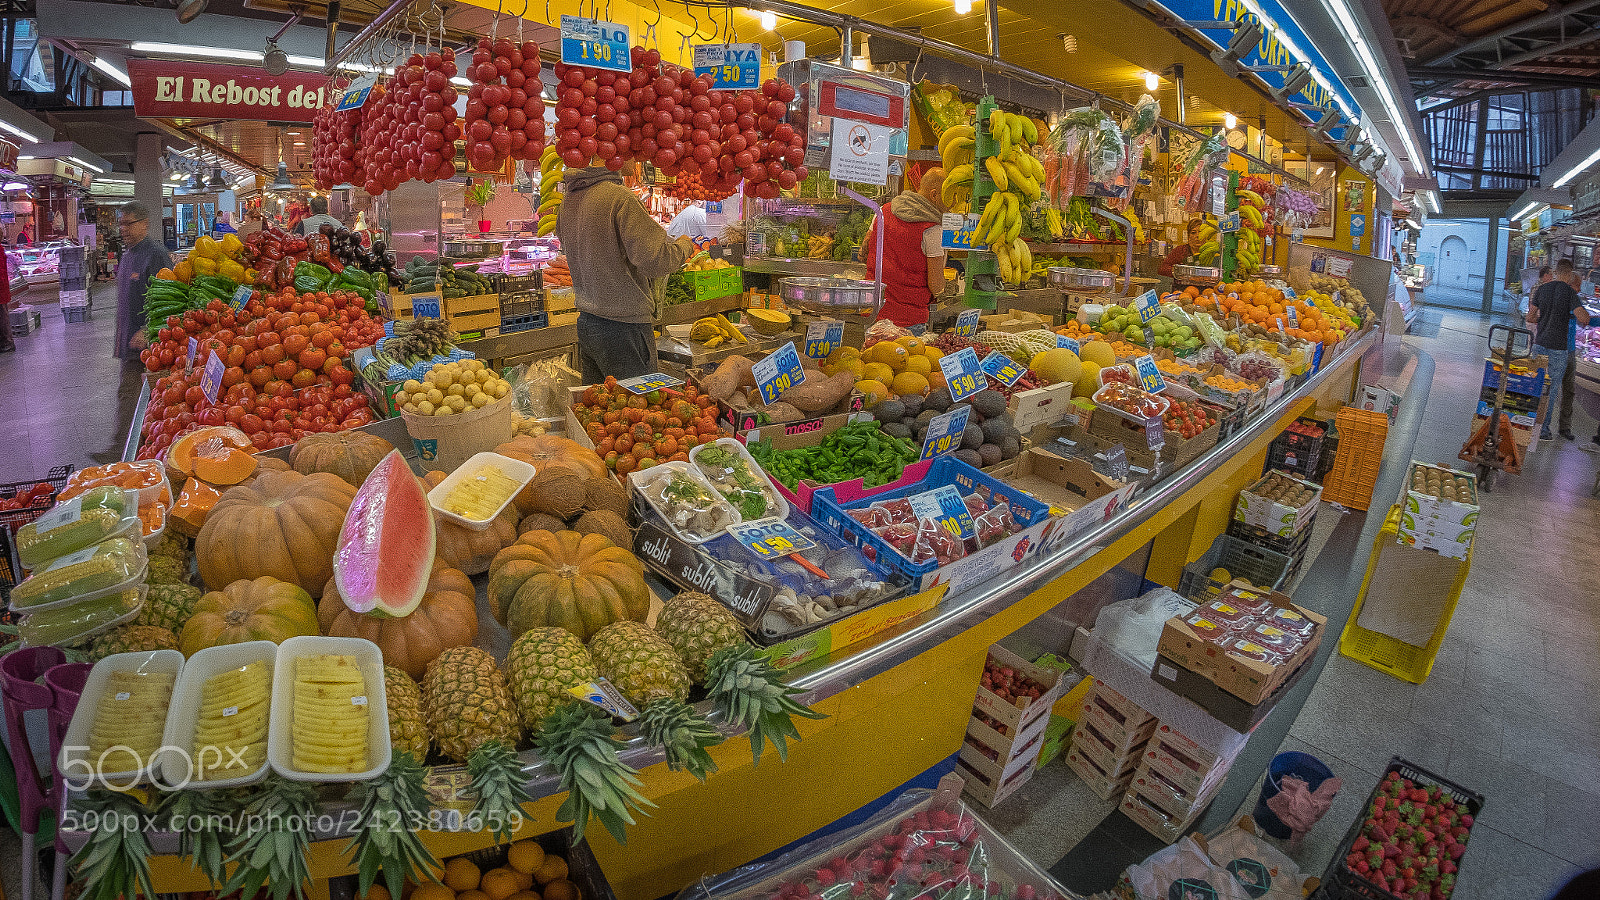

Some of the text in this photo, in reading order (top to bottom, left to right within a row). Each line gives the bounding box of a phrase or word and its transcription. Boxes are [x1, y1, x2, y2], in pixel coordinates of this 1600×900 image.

[580, 40, 611, 63] 1'90
[710, 65, 741, 82] 2'50
[156, 76, 184, 102] El
[190, 78, 281, 108] Rebost
[287, 85, 325, 110] del
[413, 303, 440, 315] SOTO
[959, 313, 978, 326] SOTO
[809, 340, 830, 356] 6'90
[776, 351, 796, 371] SOTO
[961, 354, 978, 369] SOTO
[766, 372, 791, 400] 2'90
[951, 374, 976, 396] 5'90
[926, 435, 952, 458] 2'90
[939, 495, 965, 512] SOTO
[737, 523, 787, 542] SOTO
[752, 536, 793, 555] 4'50
